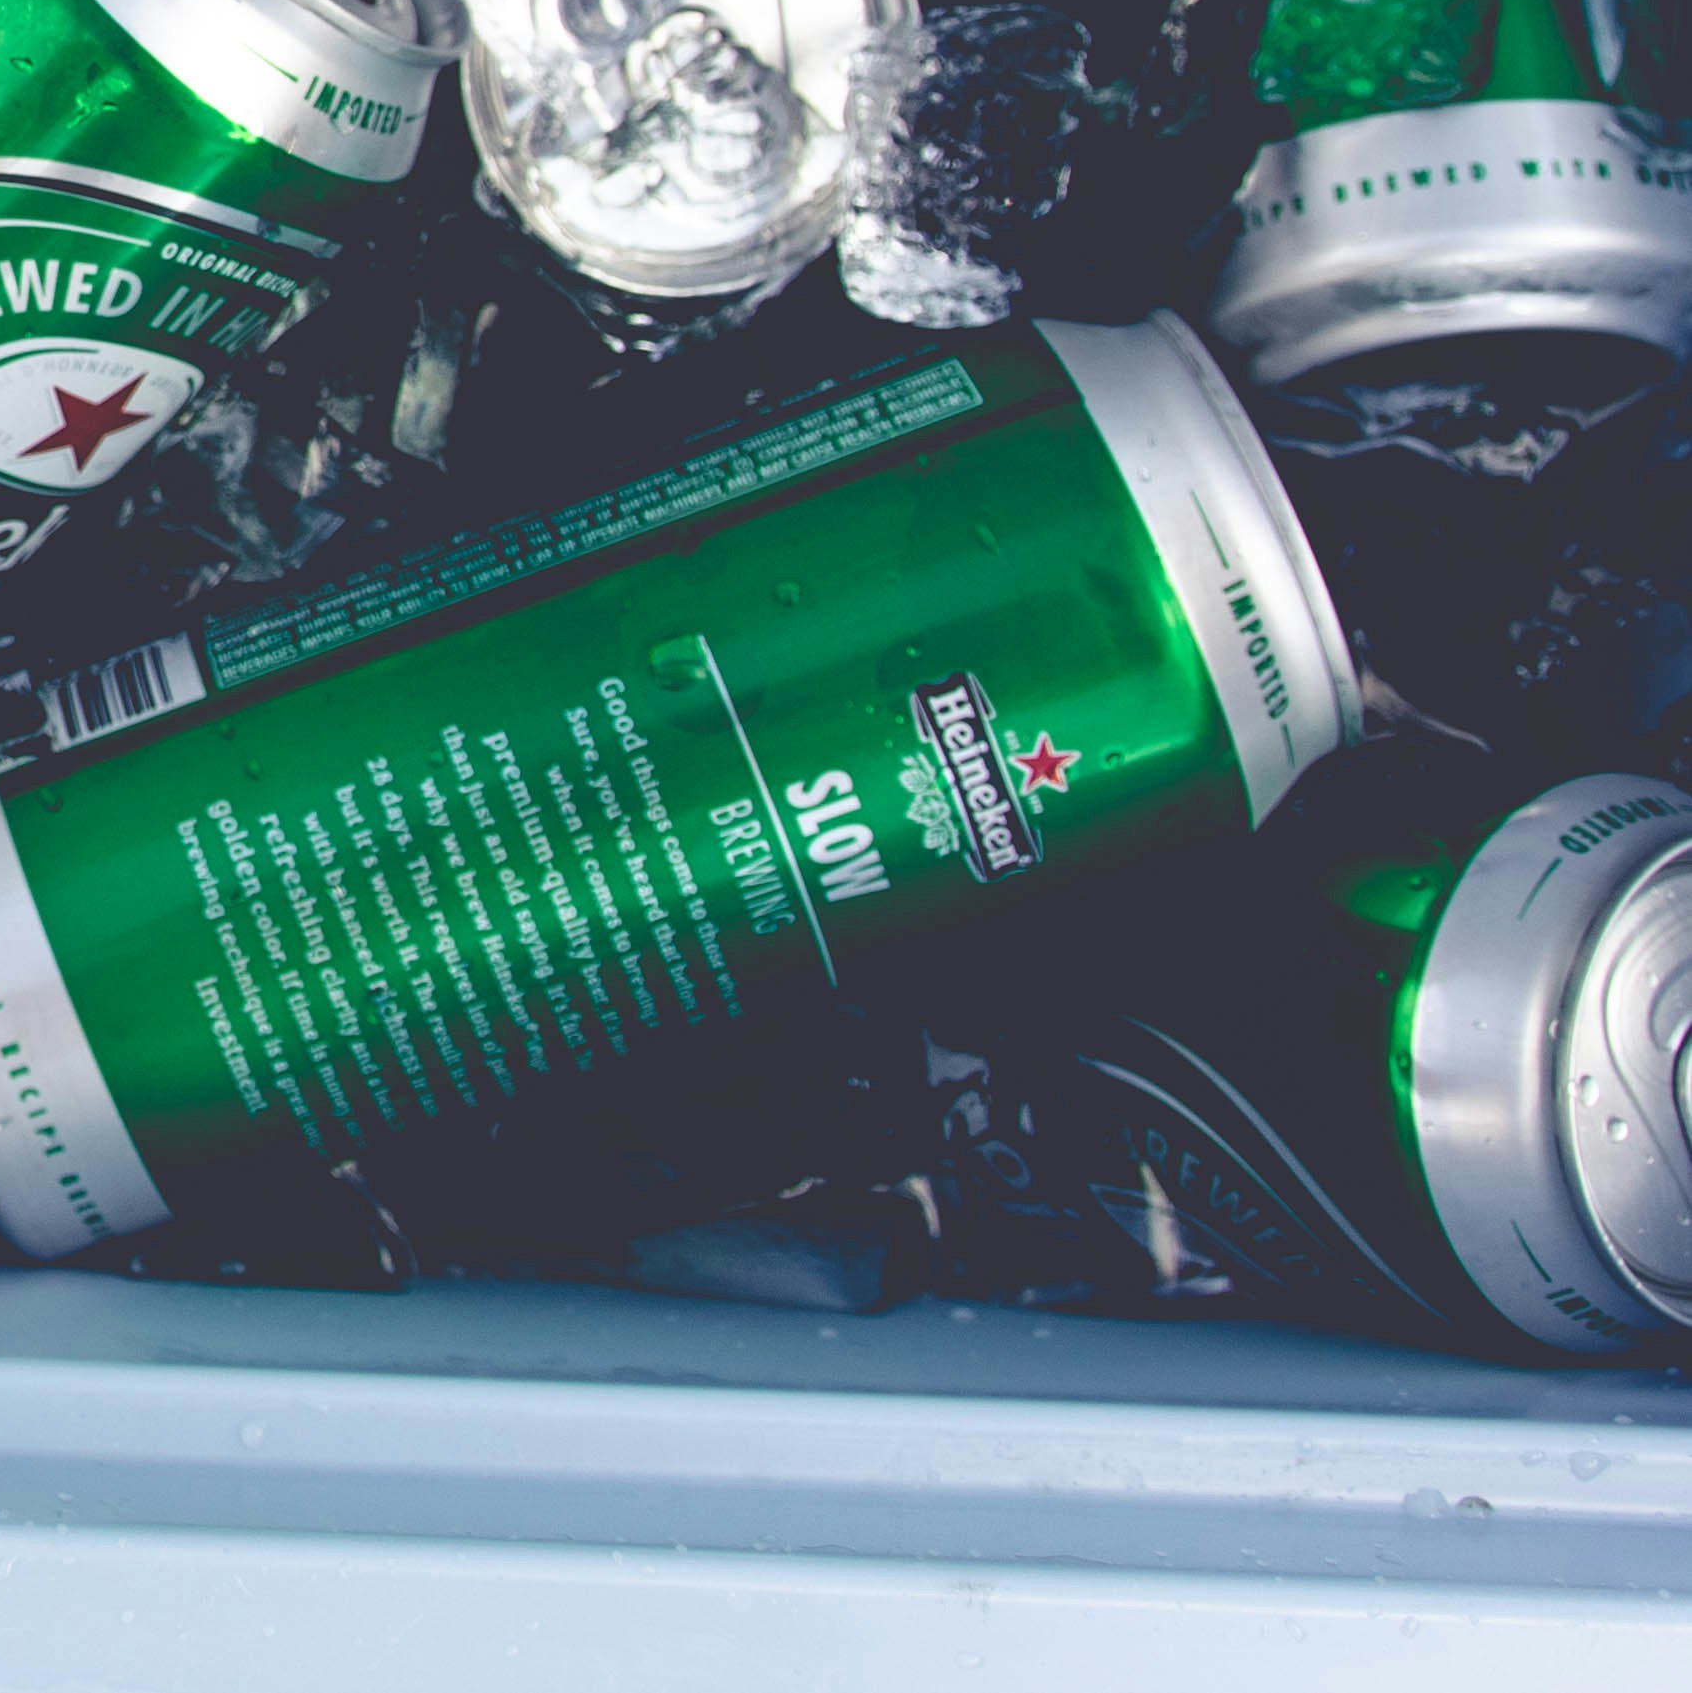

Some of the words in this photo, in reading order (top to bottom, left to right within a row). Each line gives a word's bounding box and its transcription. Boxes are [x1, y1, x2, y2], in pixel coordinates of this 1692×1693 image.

[305, 75, 404, 136] IMPORTED
[160, 241, 259, 286] ORIGINAL
[150, 285, 226, 339] IN
[1221, 578, 1291, 720] IMPORTED
[443, 725, 474, 780] than
[547, 765, 583, 832] when
[600, 677, 648, 752] Good
[631, 756, 673, 832] things
[662, 836, 698, 895] come
[689, 898, 707, 920] to
[926, 686, 1017, 870] Heineken
[207, 800, 261, 896] golden
[458, 782, 496, 828] just
[483, 732, 593, 959] premium-quality
[485, 834, 508, 864] an
[566, 707, 599, 772] Sure,
[589, 775, 636, 852] you've
[626, 854, 668, 922] heard
[655, 923, 680, 960] that
[574, 835, 594, 854] it
[787, 768, 890, 902] SLOW
[366, 757, 393, 786] 28
[381, 791, 413, 846] days.
[408, 855, 437, 907] This
[428, 911, 476, 1002] requires
[468, 1003, 499, 1037] lots
[420, 777, 450, 827] why
[442, 833, 465, 867] we
[457, 870, 492, 931] brew
[499, 868, 531, 906] old
[583, 858, 622, 929] comes
[710, 797, 797, 936] BREWING
[178, 818, 225, 920] brewing
[218, 922, 273, 1034] technique
[264, 1038, 282, 1058] is
[273, 1061, 289, 1073] a
[251, 902, 287, 962] color.
[260, 813, 331, 964] refreshing
[320, 968, 360, 1036] clarity
[351, 1042, 377, 1071] and
[303, 811, 336, 866] with
[325, 868, 384, 977] balanced
[369, 979, 419, 1071] richness
[335, 784, 364, 827] but
[352, 829, 379, 869] it's
[371, 873, 411, 943] worth
[398, 945, 420, 966] it.
[411, 971, 437, 1011] The
[429, 1015, 458, 1055] result
[613, 930, 631, 953] to
[279, 970, 304, 990] If
[289, 993, 319, 1040] time
[195, 976, 261, 1103] investment
[310, 1043, 328, 1061] is
[1, 1042, 65, 1158] RECIPE
